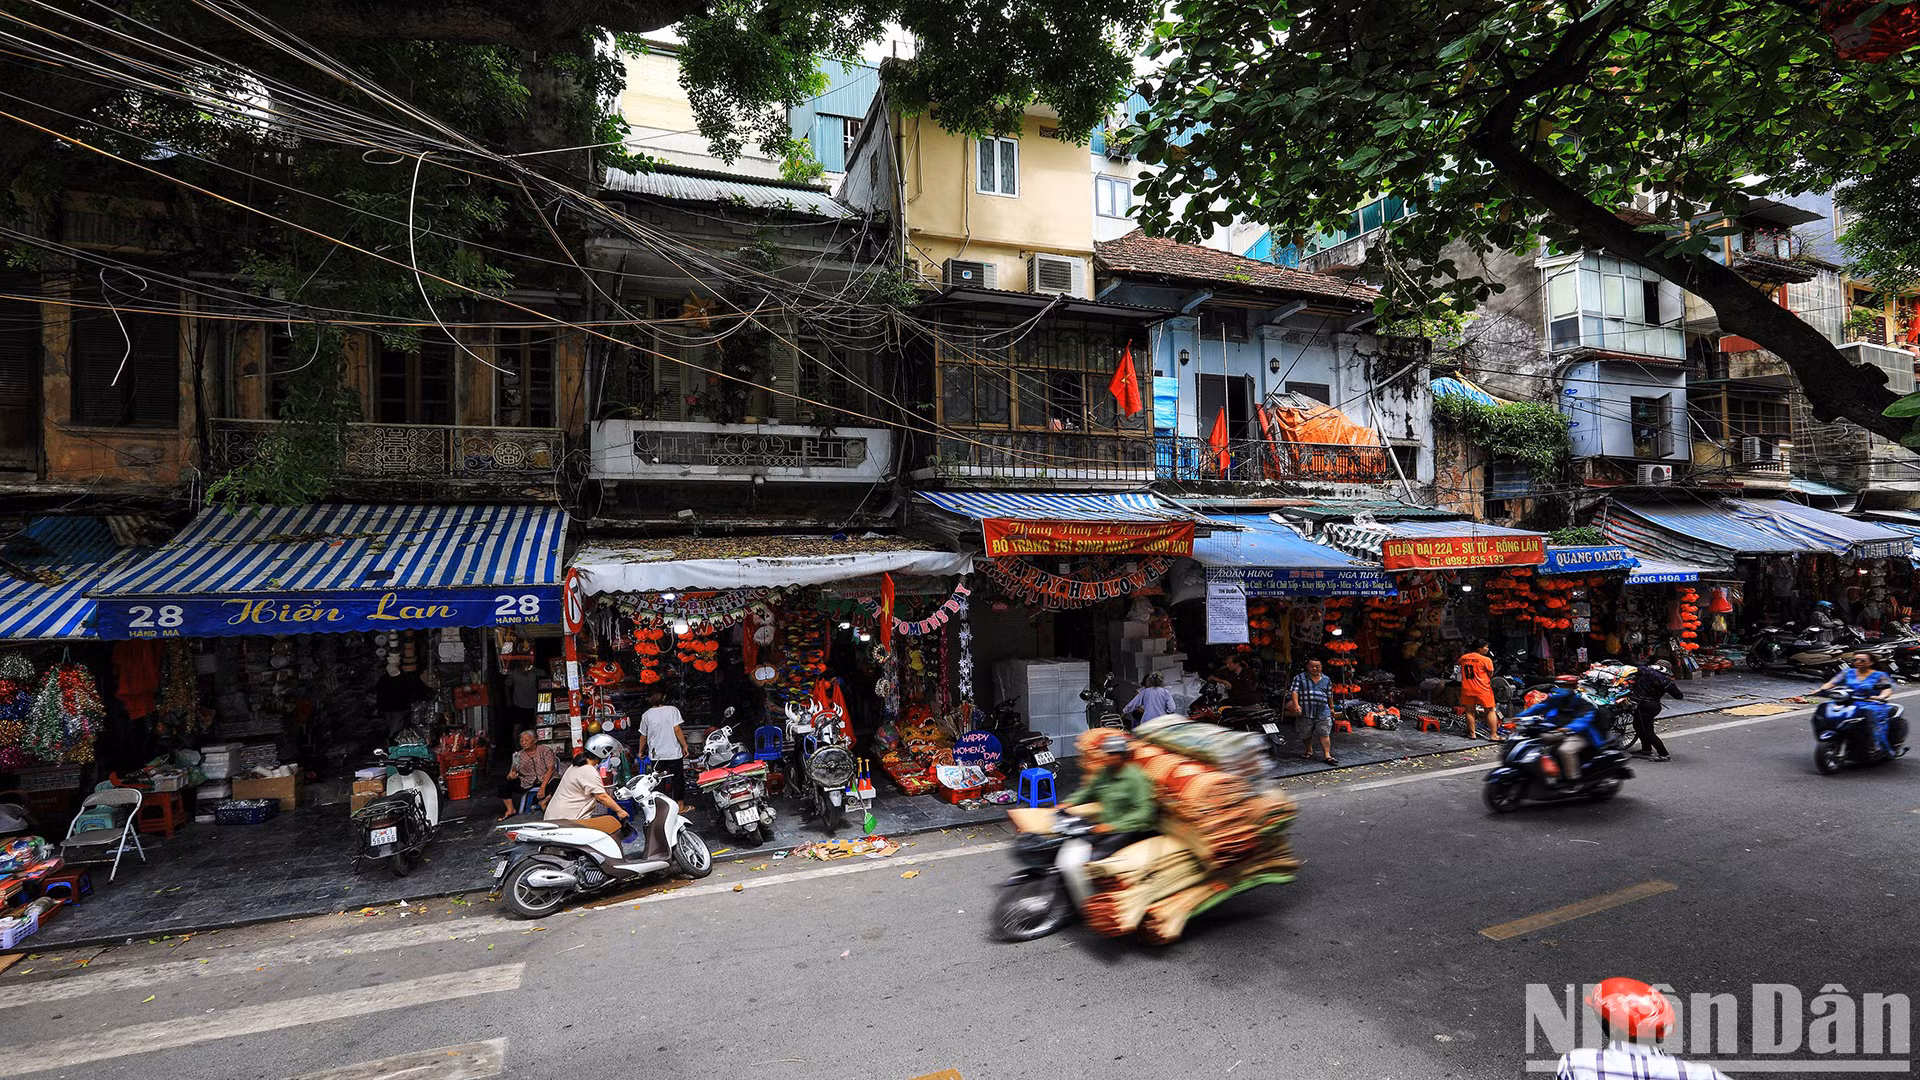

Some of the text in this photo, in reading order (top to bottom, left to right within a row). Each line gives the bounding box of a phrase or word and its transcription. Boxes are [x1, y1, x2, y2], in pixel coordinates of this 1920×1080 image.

[1097, 525, 1112, 535] 24
[1011, 539, 1051, 553] TRANG
[1054, 536, 1072, 553] TRÍ
[1074, 539, 1104, 553] SINH
[1417, 543, 1433, 558] ĐẠI
[1435, 542, 1453, 555] 22A
[1521, 537, 1539, 552] LÂN
[1445, 555, 1469, 566] 0982
[1470, 555, 1486, 565] 835
[1488, 554, 1505, 564] 133
[1556, 551, 1593, 567] QUANG
[1068, 553, 1177, 600] HALLOWEEN
[1338, 571, 1357, 579] NGA
[1659, 575, 1681, 583] HOA
[1685, 574, 1698, 582] 18
[494, 594, 540, 616] 28
[944, 582, 971, 614] DAY
[128, 605, 184, 628] 28
[221, 592, 458, 625] Hiển Lan
[962, 733, 990, 743] HAPPY
[953, 744, 986, 755] WOMEN'S
[983, 752, 1001, 760] DAY
